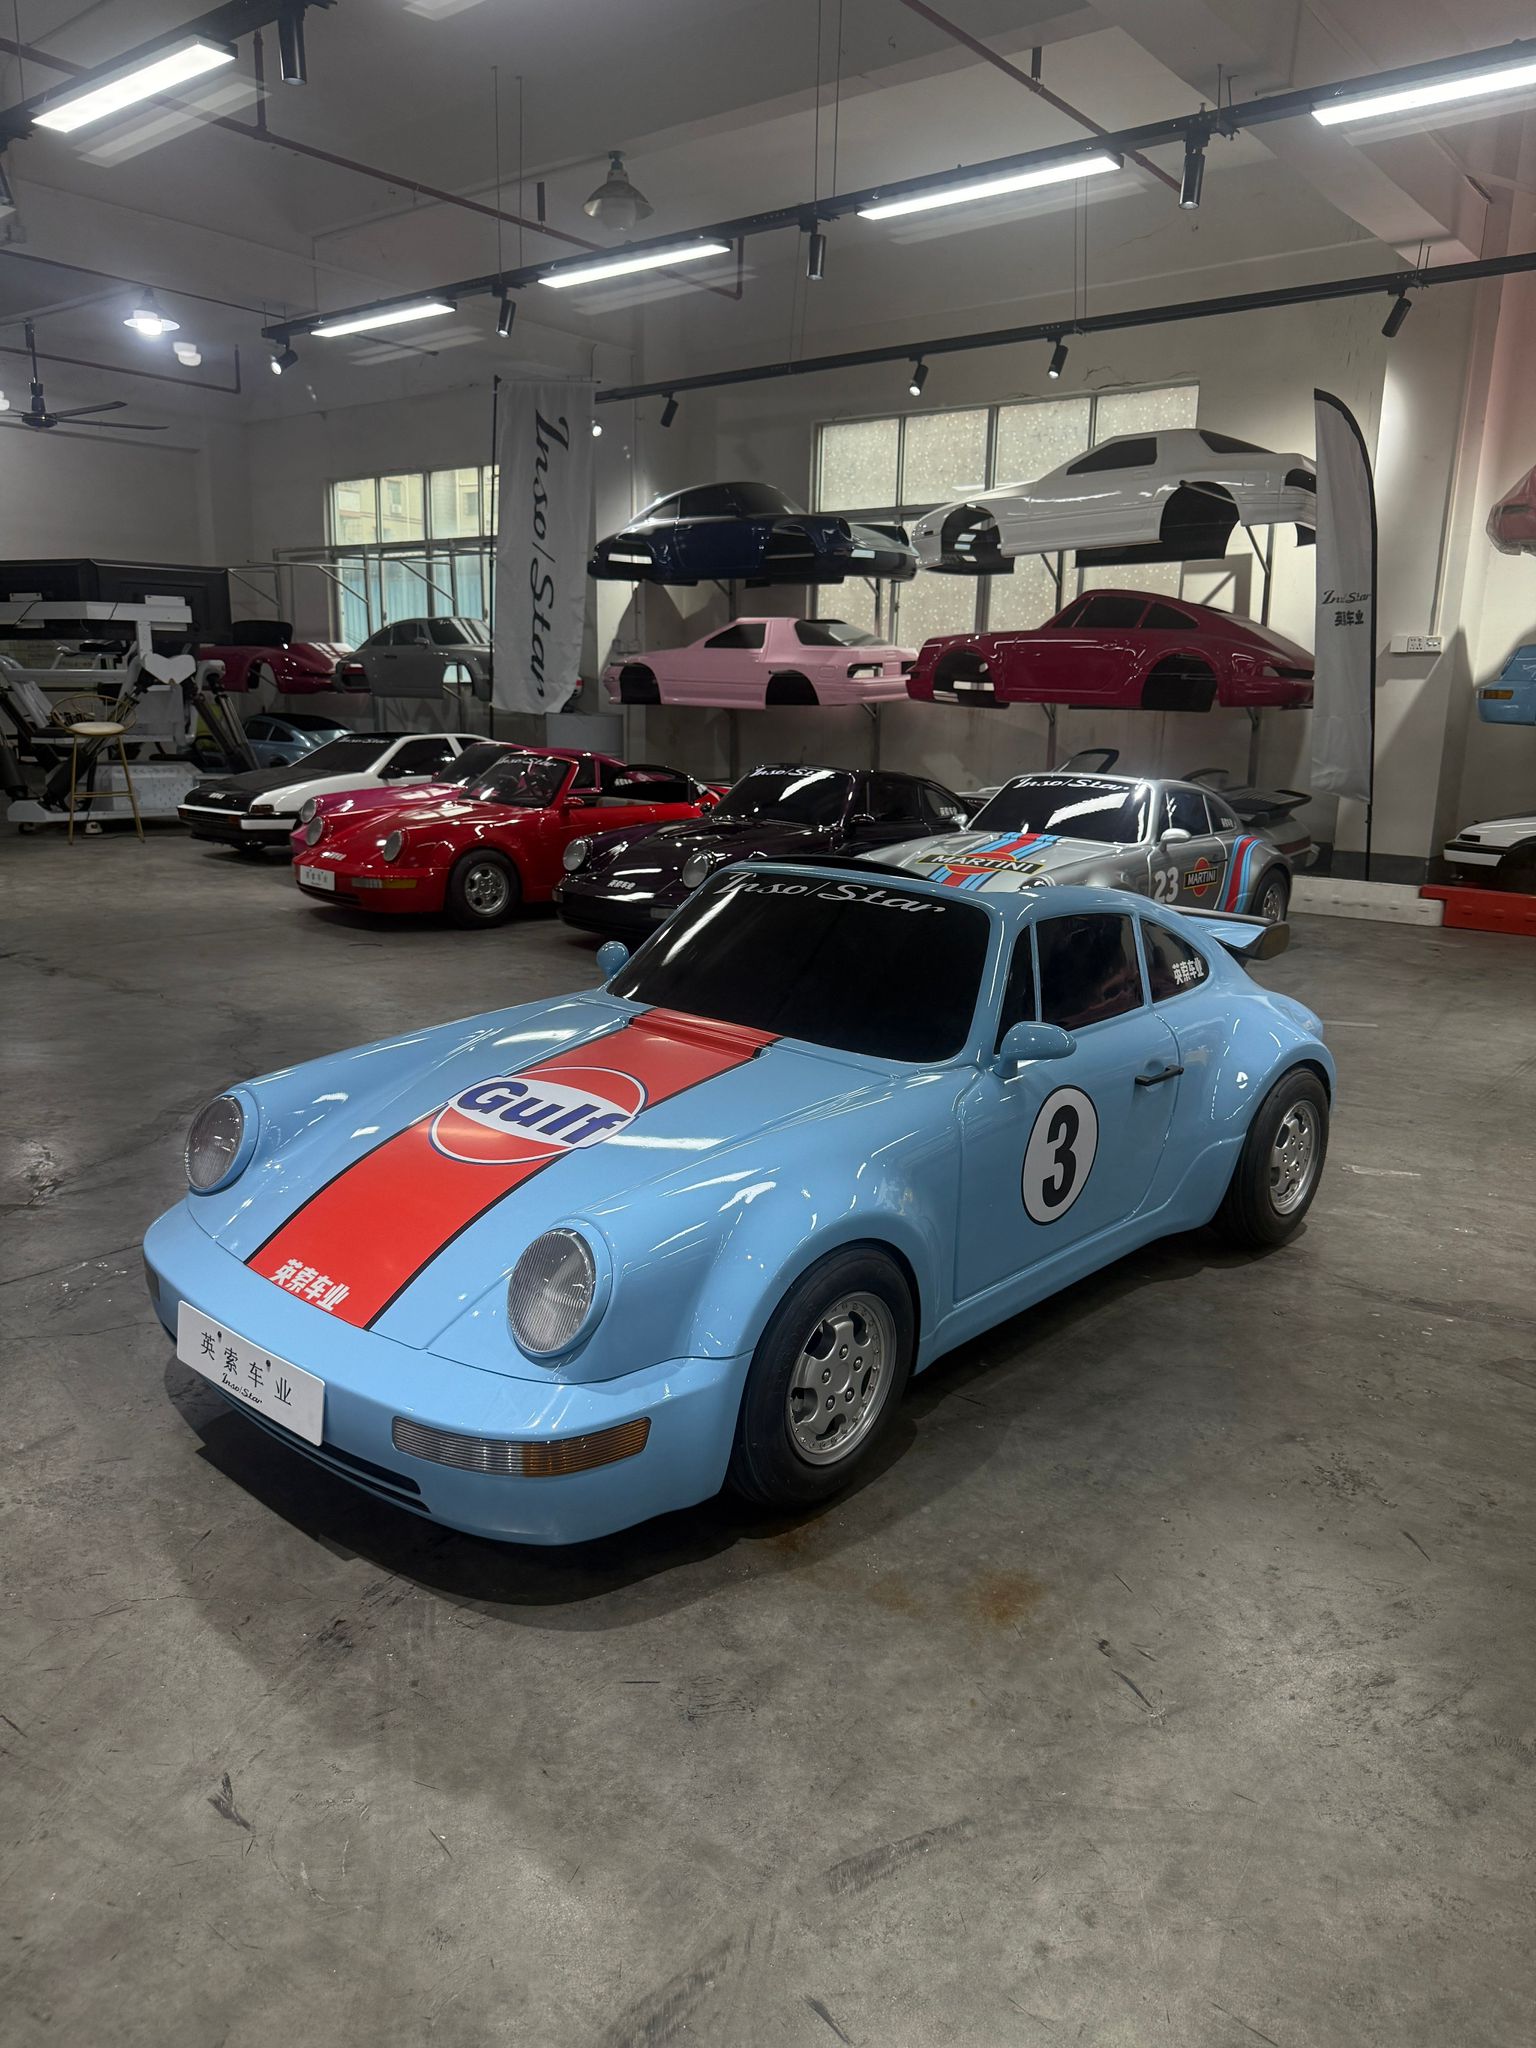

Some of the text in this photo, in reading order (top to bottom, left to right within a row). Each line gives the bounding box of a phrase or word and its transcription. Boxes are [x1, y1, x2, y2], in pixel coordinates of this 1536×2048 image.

[931, 855, 1034, 872] MARTINI
[1154, 866, 1179, 903] 23
[1187, 869, 1216, 885] MARTINI
[1172, 957, 1204, 985] 英索车业
[457, 1081, 632, 1145] Gulf
[1042, 1104, 1080, 1208] 3
[269, 1258, 350, 1312] 英索车业
[200, 1331, 292, 1406] 英索车业
